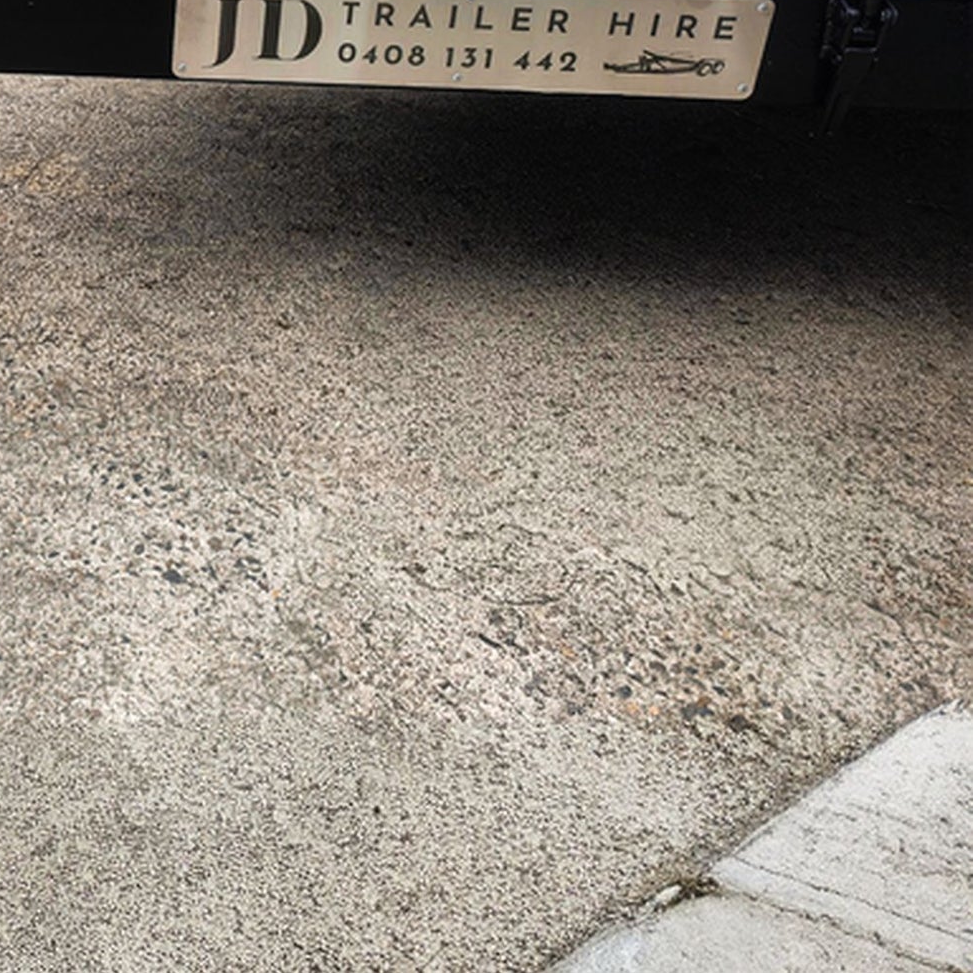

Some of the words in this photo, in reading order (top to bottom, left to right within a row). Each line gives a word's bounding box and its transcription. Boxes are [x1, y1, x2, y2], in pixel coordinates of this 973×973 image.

[342, 0, 570, 34] TRAILER
[609, 11, 738, 40] HIRE
[338, 42, 427, 67] 0408
[445, 46, 493, 69] 131
[514, 51, 578, 73] 442
